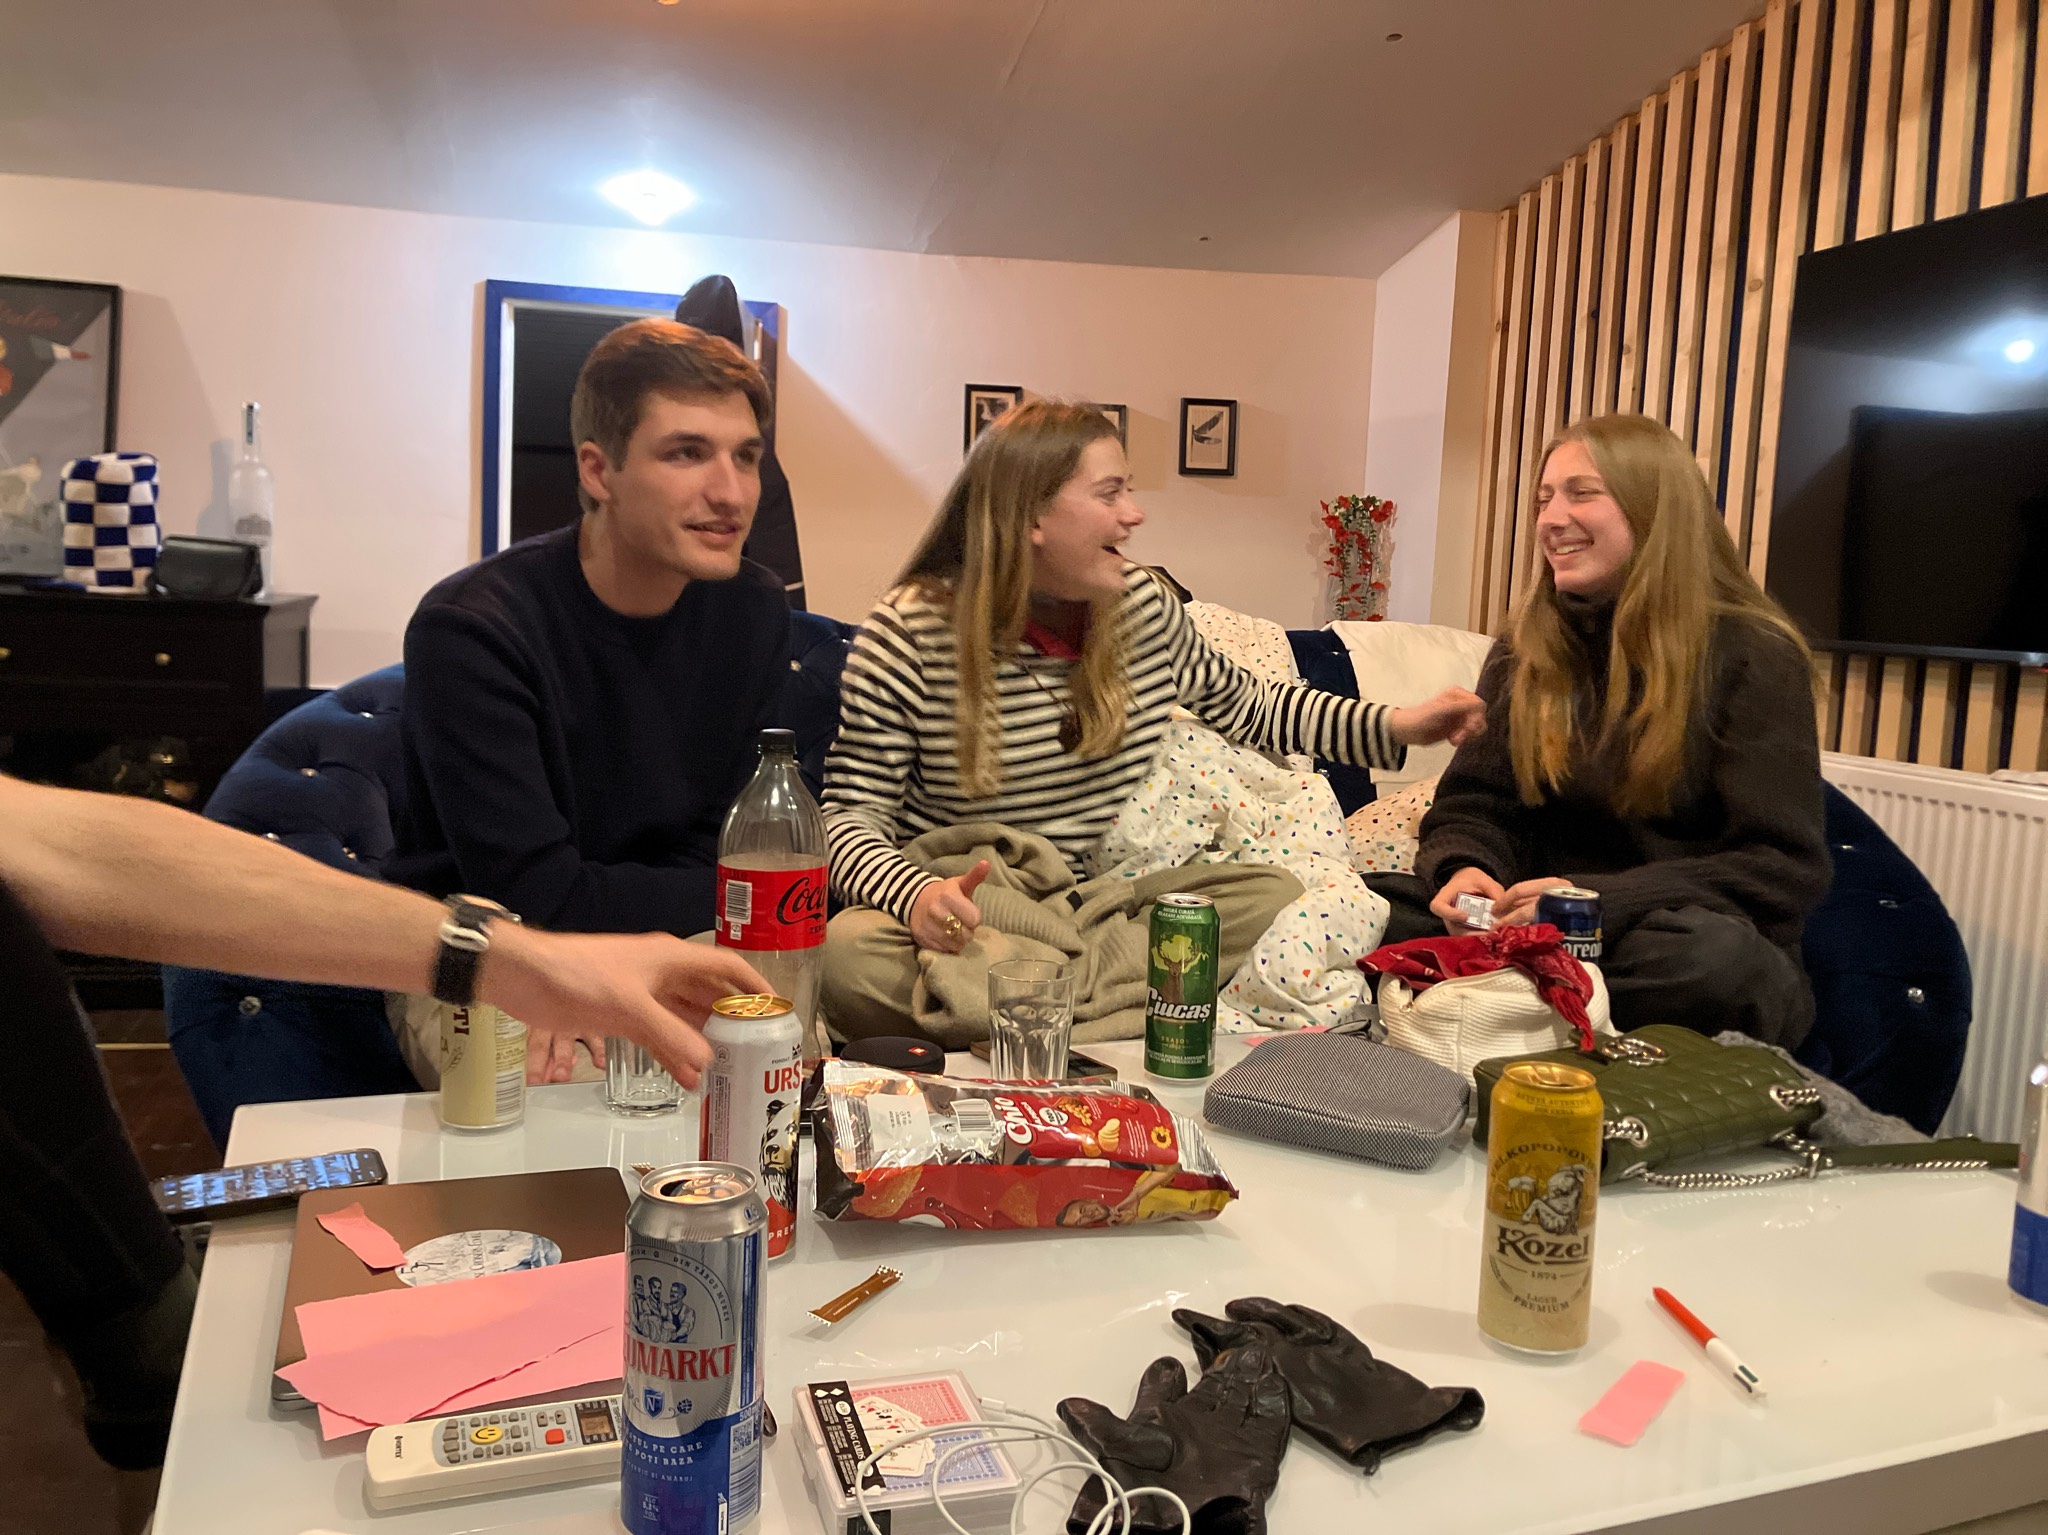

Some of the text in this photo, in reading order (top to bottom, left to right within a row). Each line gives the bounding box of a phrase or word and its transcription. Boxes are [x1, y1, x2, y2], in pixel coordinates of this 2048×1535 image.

[993, 1096, 1034, 1146] Chio
[1496, 1224, 1590, 1265] Kozel
[1513, 1295, 1569, 1314] PREMIUM
[652, 1443, 665, 1453] PE
[670, 1441, 703, 1454] CARE
[663, 1456, 694, 1466] BAZA
